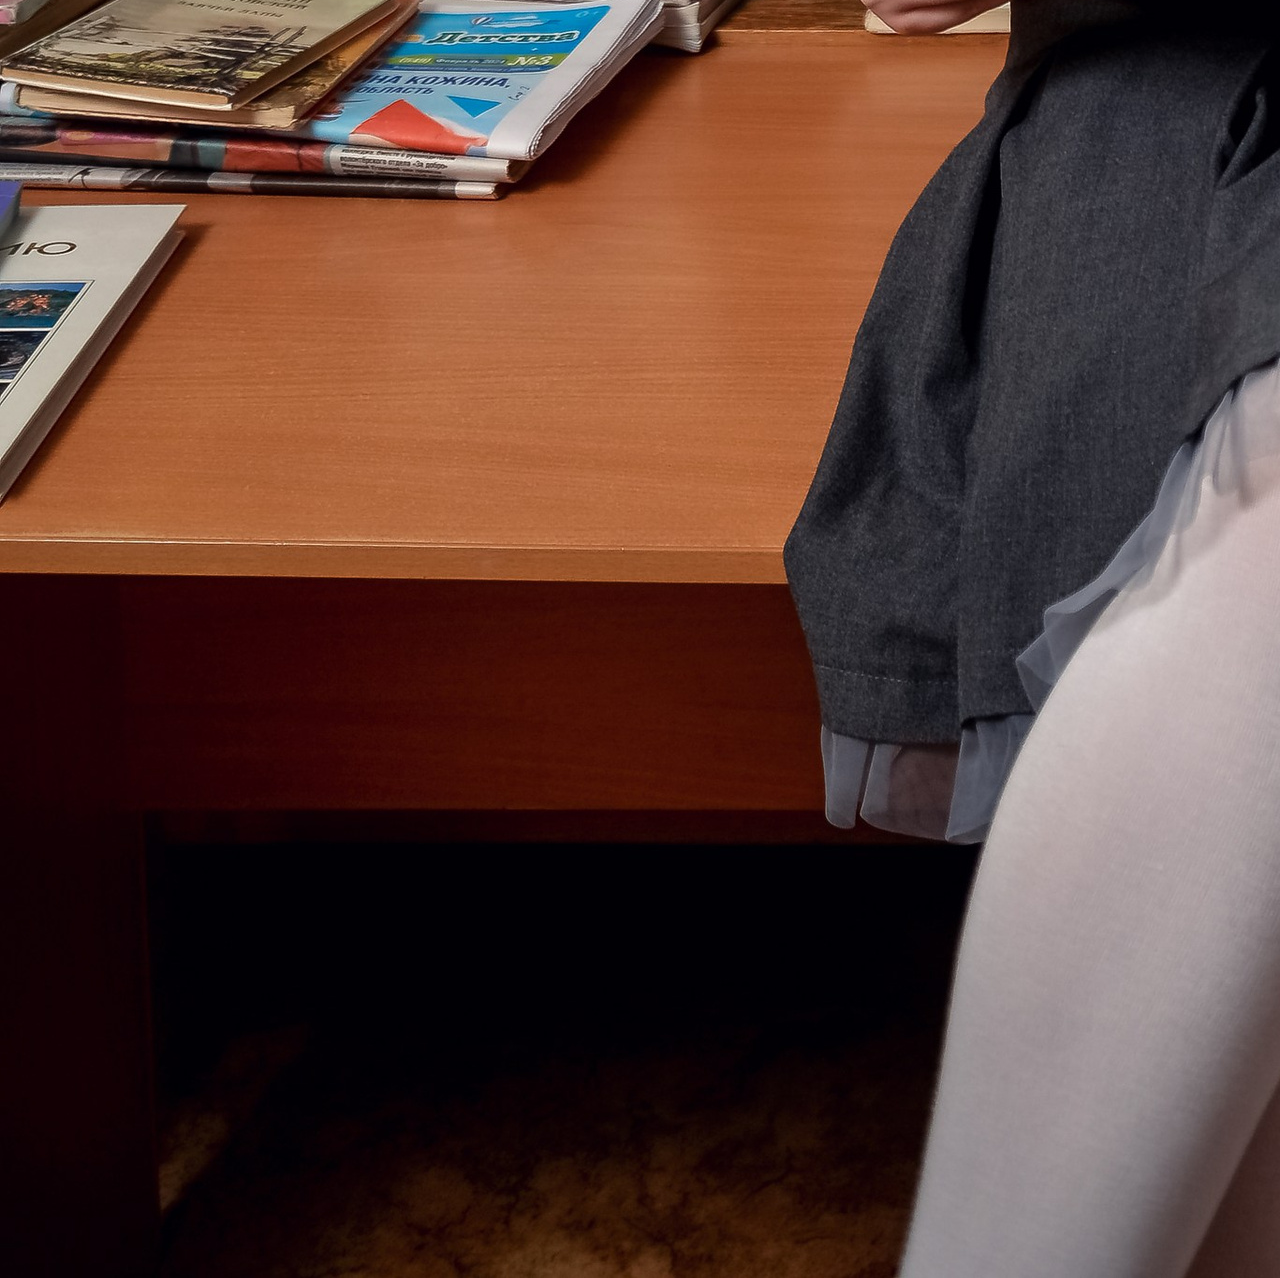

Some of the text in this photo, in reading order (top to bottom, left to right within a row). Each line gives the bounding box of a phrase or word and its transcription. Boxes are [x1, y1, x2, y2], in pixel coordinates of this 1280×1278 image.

[174, 0, 284, 18] ЗАЯЧЬИ ЛАПЫ
[424, 29, 580, 46] Детства
[507, 55, 553, 67] №3
[404, 75, 511, 89] КОЖИНА,
[356, 86, 434, 95] ОБЛАСТЬ
